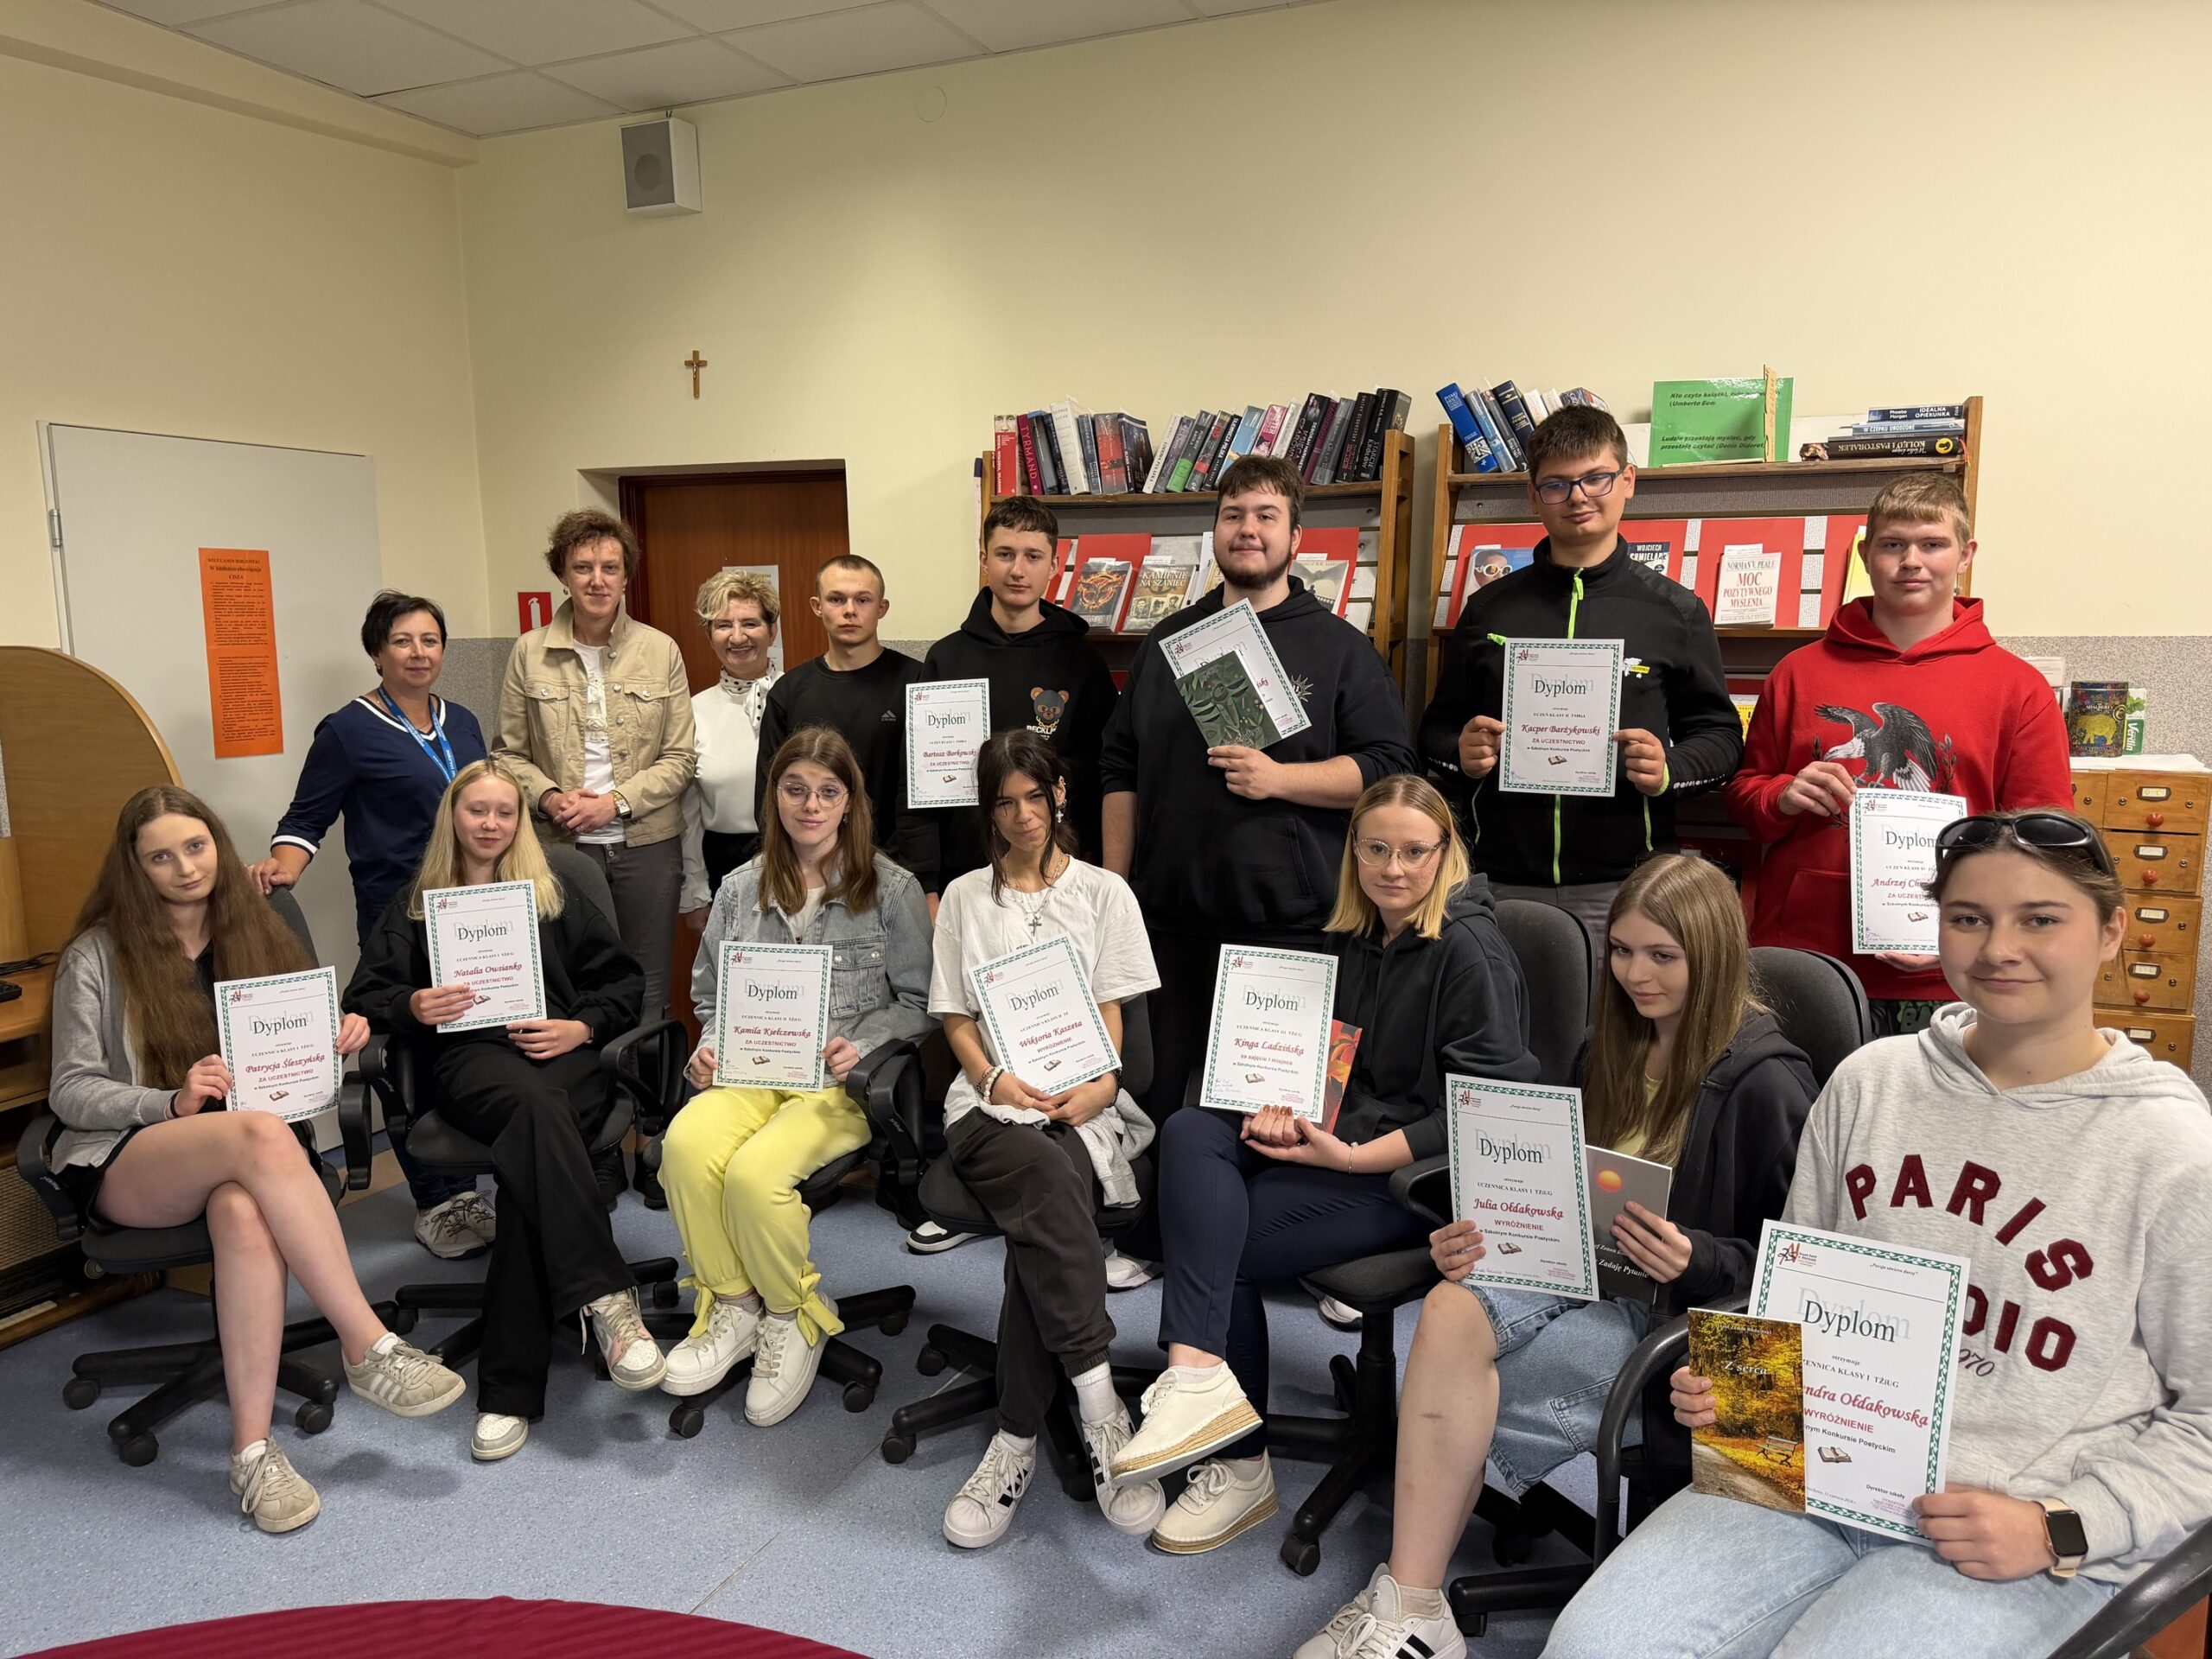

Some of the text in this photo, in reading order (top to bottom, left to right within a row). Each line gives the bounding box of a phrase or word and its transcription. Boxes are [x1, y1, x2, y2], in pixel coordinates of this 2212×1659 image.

[1224, 417, 1238, 442] TAJEMNICZA
[1020, 425, 1036, 479] TYRMAND
[1217, 442, 1228, 458] POLSKA
[1142, 571, 1188, 581] KAMIENIE
[1737, 572, 1762, 587] MOC
[1724, 587, 1772, 597] POZYTYWNEGO
[1535, 680, 1586, 697] Dyplom
[928, 714, 965, 728] Dyplom
[1522, 724, 1548, 734] Kacper
[2126, 723, 2139, 751] Verdin
[1885, 831, 1936, 849] Dyplom
[1871, 878, 1907, 888] Andrzej
[458, 924, 506, 943] Dyplom
[454, 962, 522, 978] Natalia Owsianko
[472, 976, 513, 986] UCZESTNICTWO
[748, 985, 798, 1001] Dyplom
[1010, 986, 1058, 1011] Dyplom
[1246, 991, 1299, 1011] Dyplom
[253, 1016, 307, 1036] Dyplom
[734, 1026, 810, 1038] Kamila Kiełczewska
[1019, 1021, 1083, 1048] Wiktoria Kaszeta
[1235, 1038, 1259, 1050] Kinga
[245, 1053, 325, 1074] Patrycja Śleszyńska
[268, 1069, 314, 1082] UCZESTNICTWO
[1480, 1138, 1543, 1164] Dyplom
[1478, 1182, 1509, 1191] UCZENNICA
[1473, 1198, 1563, 1220] Julia Ołdakowska
[1494, 1219, 1544, 1230] WYRÓŻNIENIE
[1846, 1154, 2094, 1292] PARIS
[1599, 1259, 1622, 1272] Zadaję
[1802, 1300, 1896, 1343] Dyplom
[1724, 1360, 1767, 1374] Z serca
[1832, 1355, 1860, 1365] otrzymuje
[1802, 1358, 1836, 1373] ENNICA
[1838, 1368, 1866, 1379] KLASY
[1874, 1376, 1899, 1388] TŻiUG
[1840, 1393, 1929, 1427] Ołdakowska
[1804, 1408, 1873, 1433] WYRÓŻNIENIE
[1822, 1428, 1857, 1443] Konkursie
[1859, 1438, 1896, 1453] Poetyckim
[1866, 1484, 1905, 1499] Dyrektor szkoły
